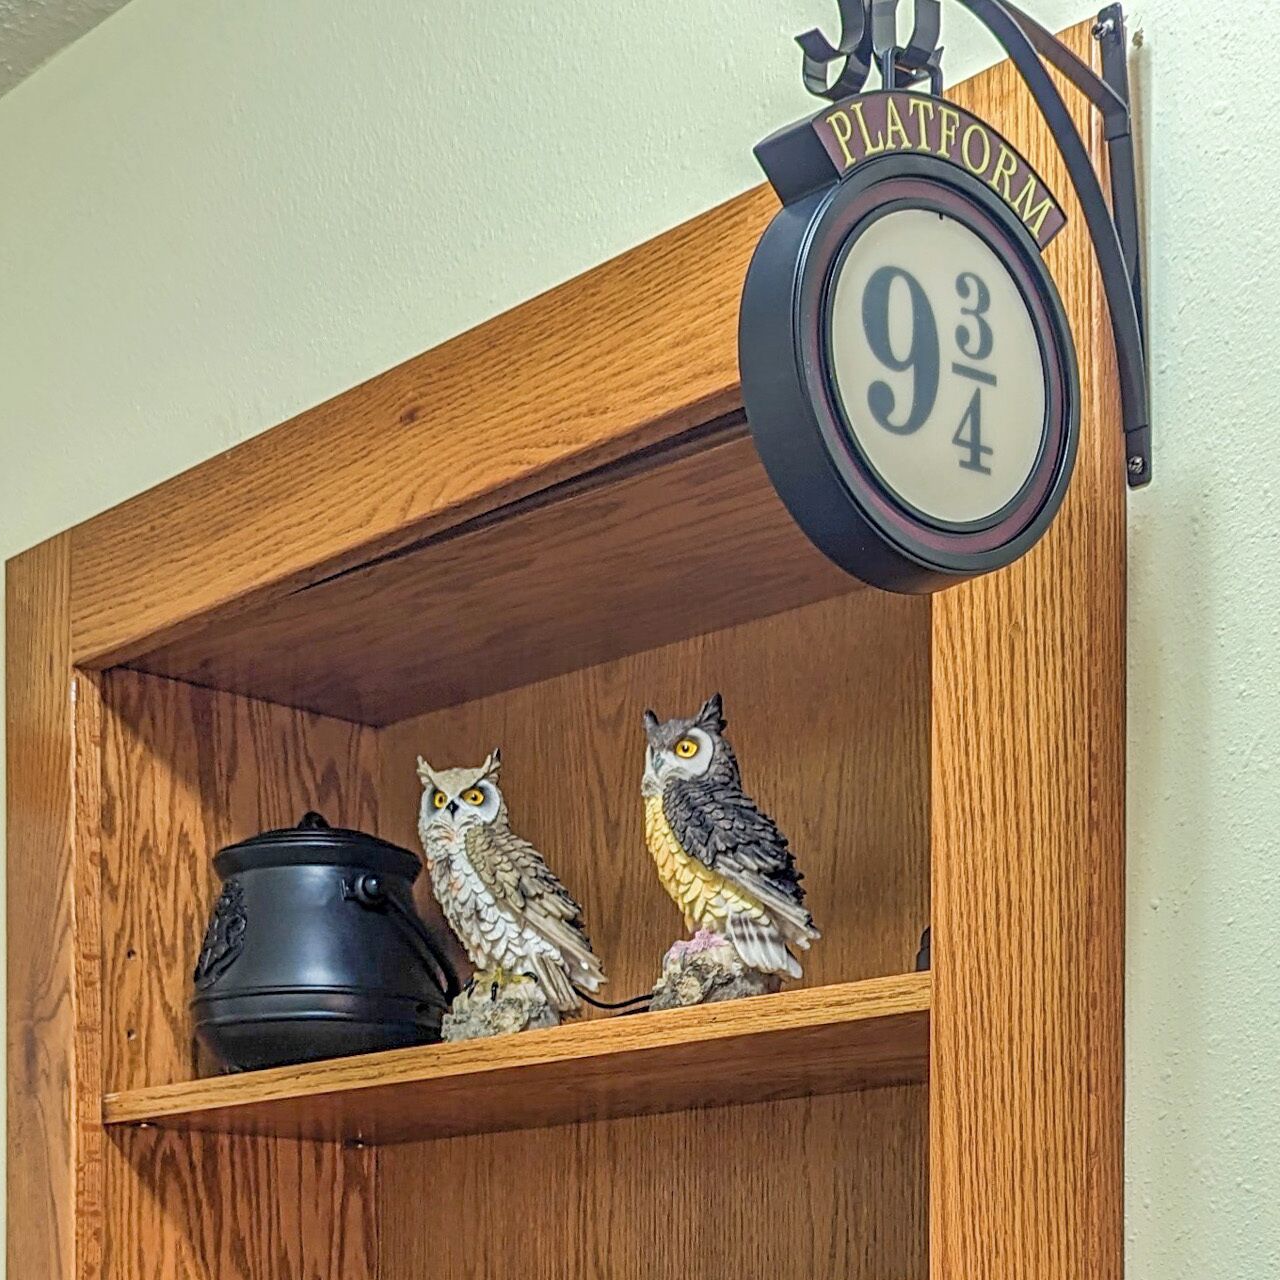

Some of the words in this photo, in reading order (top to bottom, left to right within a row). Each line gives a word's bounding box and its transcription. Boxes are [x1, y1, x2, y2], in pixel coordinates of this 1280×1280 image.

[826, 97, 1056, 239] PLATFORM
[861, 265, 941, 436] 9
[955, 271, 995, 361] 3
[951, 387, 994, 476] 4
